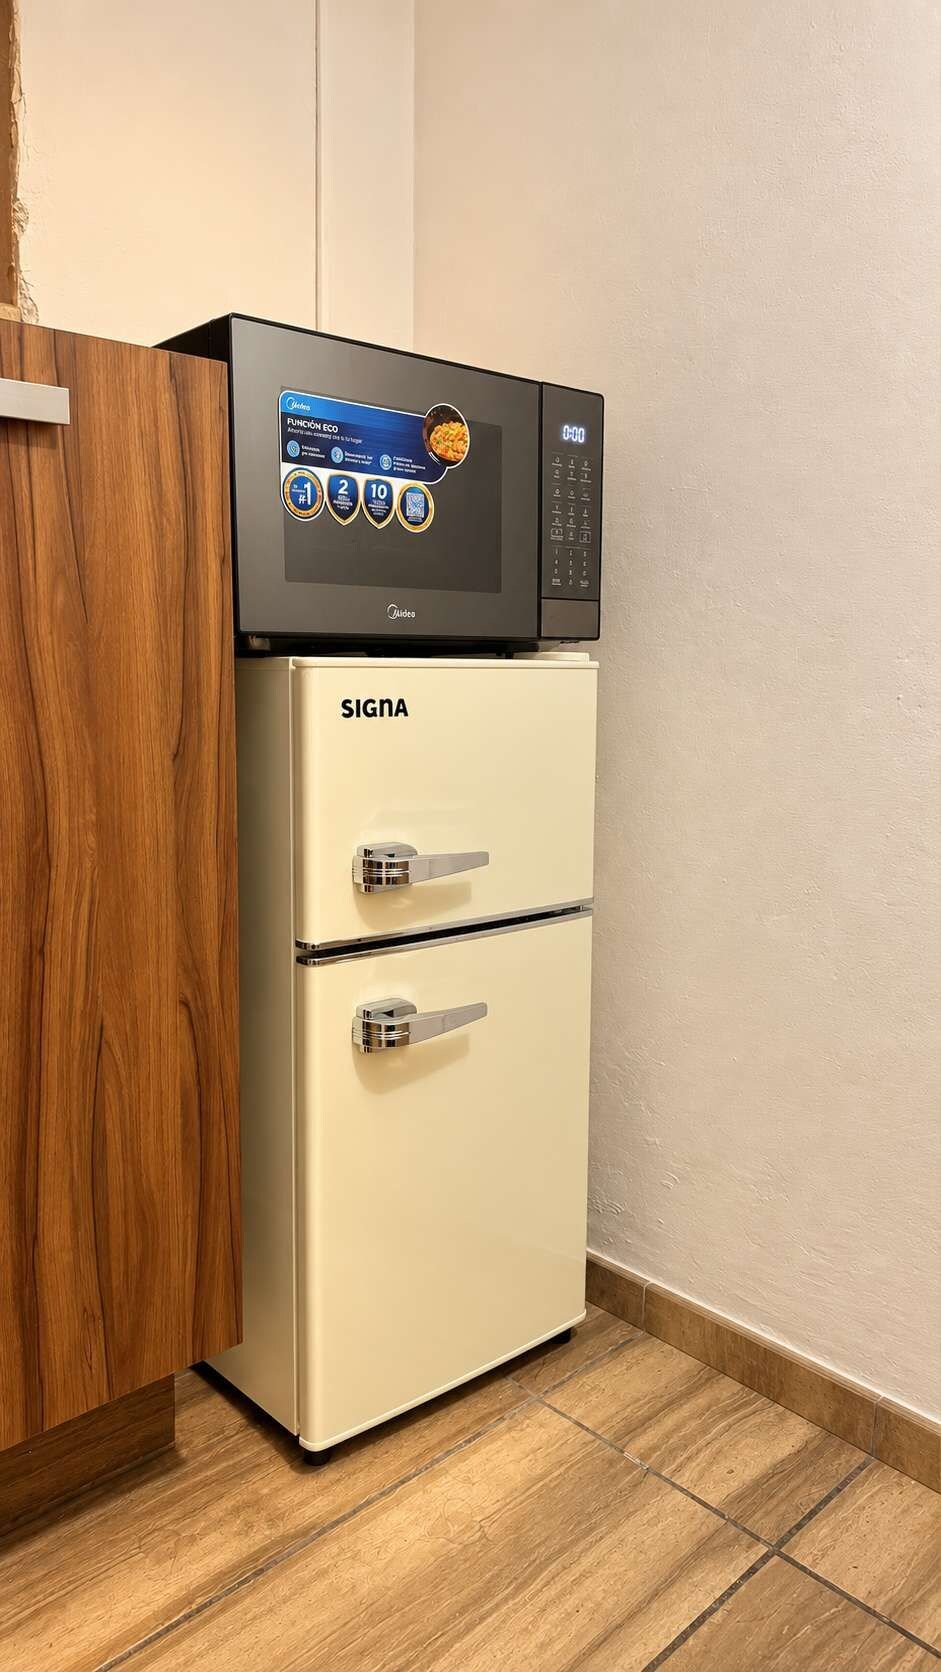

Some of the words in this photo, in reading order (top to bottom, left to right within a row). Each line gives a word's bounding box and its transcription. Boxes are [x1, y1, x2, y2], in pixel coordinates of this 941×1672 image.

[287, 418, 321, 430] FUNCIÓN
[322, 423, 338, 433] ECO
[563, 425, 585, 443] 0:00
[338, 479, 349, 495] 2
[371, 483, 388, 500] 10
[387, 603, 416, 620] Midea
